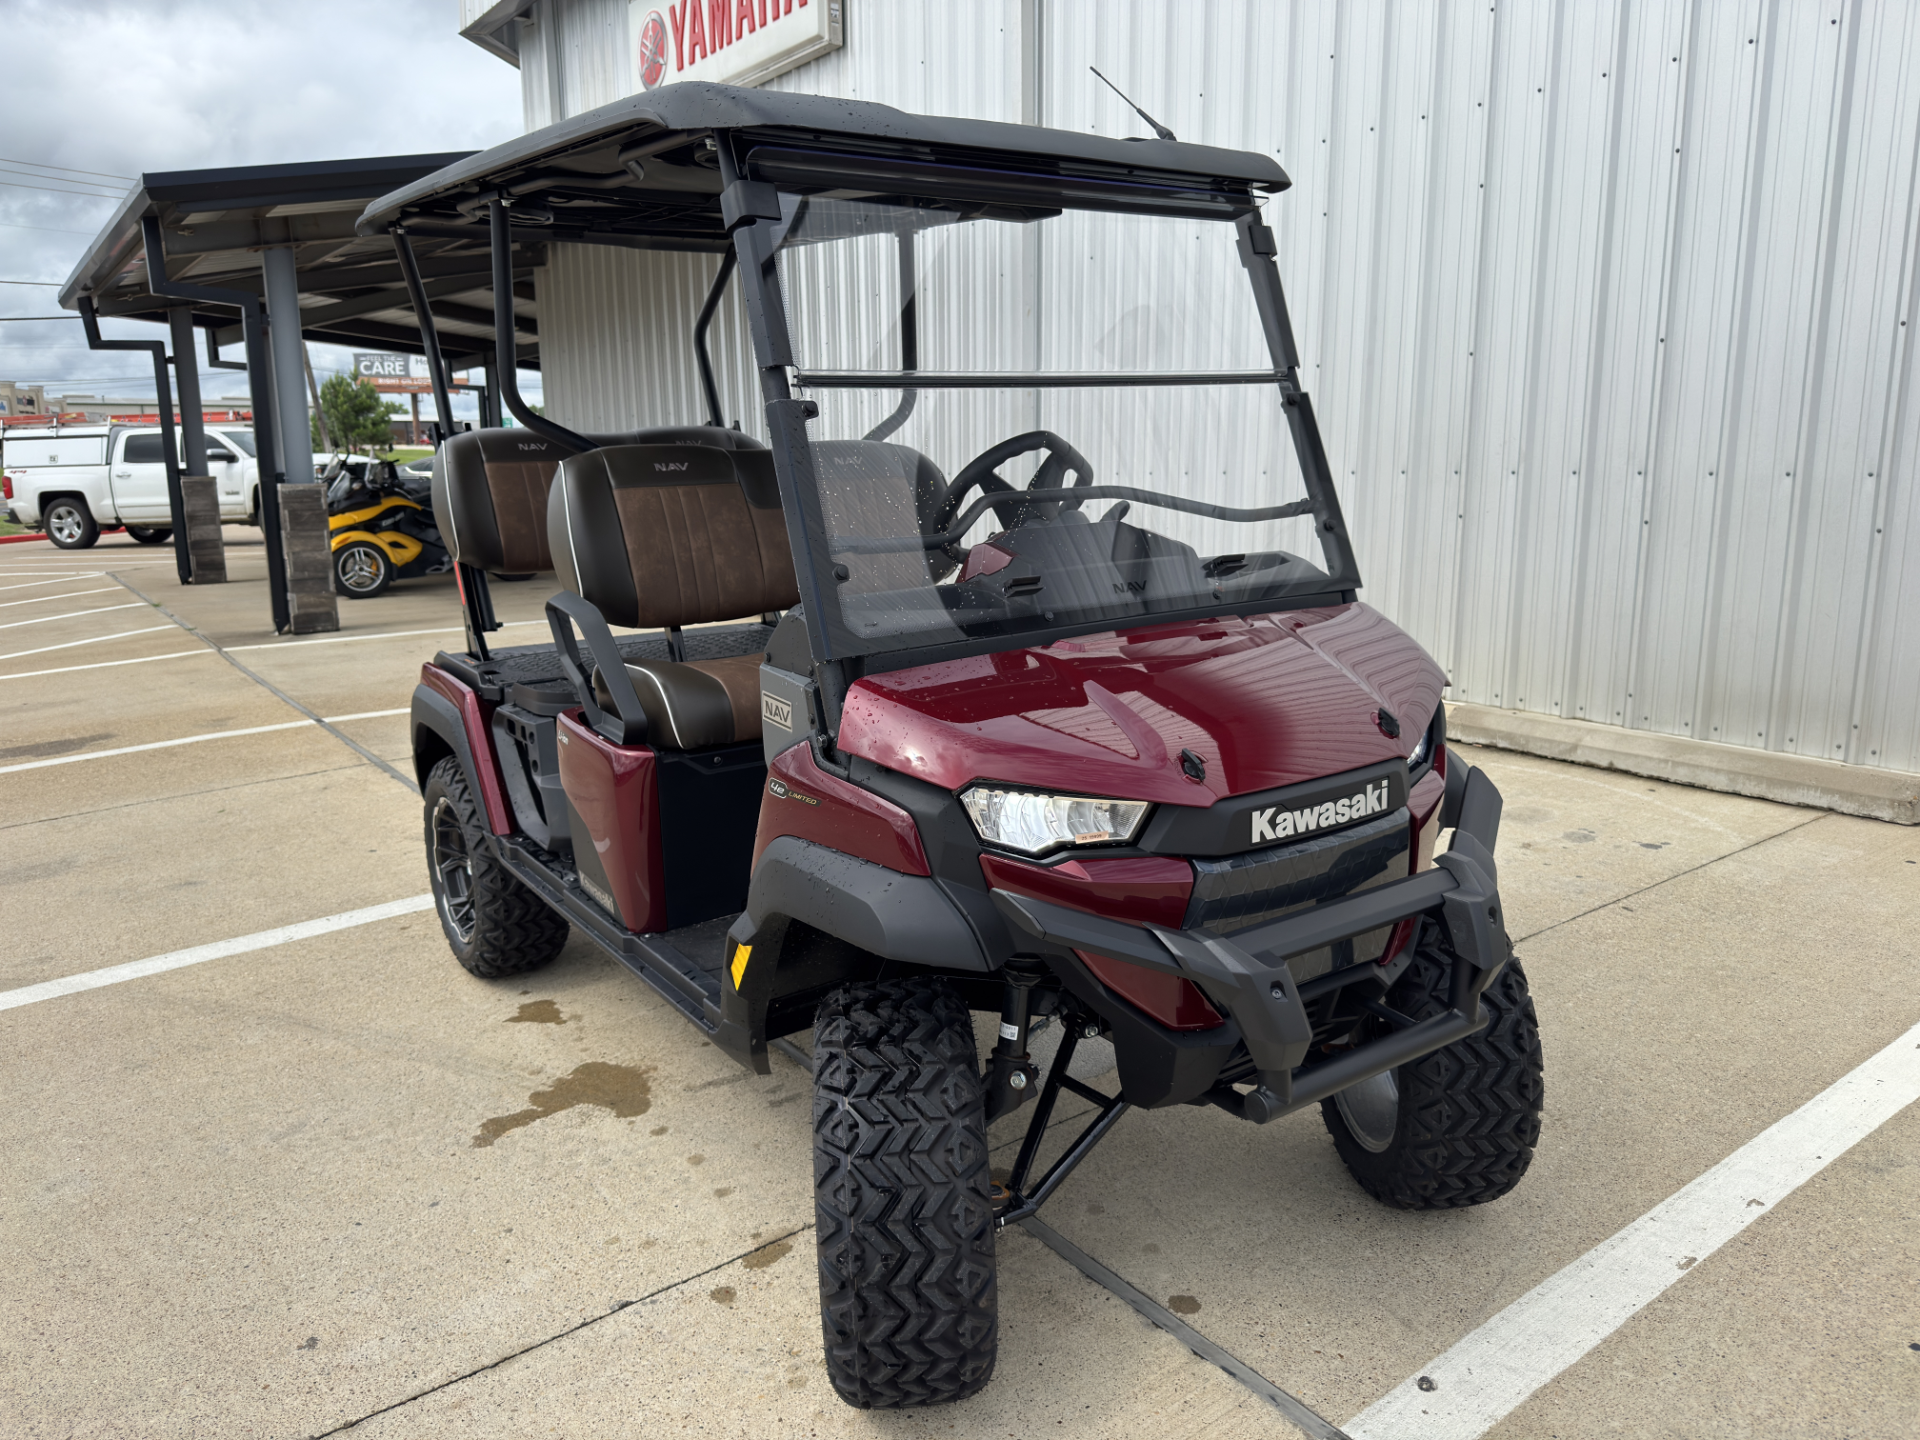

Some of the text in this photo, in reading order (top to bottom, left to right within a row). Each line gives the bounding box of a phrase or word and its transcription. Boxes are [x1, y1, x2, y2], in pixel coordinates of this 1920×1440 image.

[669, 0, 808, 71] YAMA
[359, 361, 405, 375] CARE
[378, 377, 399, 385] RIGHT
[518, 443, 548, 451] NAV
[653, 462, 689, 471] NAV
[834, 457, 862, 465] NAV
[1111, 580, 1147, 594] NAV
[765, 700, 790, 722] NAV
[788, 791, 817, 805] LIMITED
[1251, 779, 1388, 844] Kawasaki
